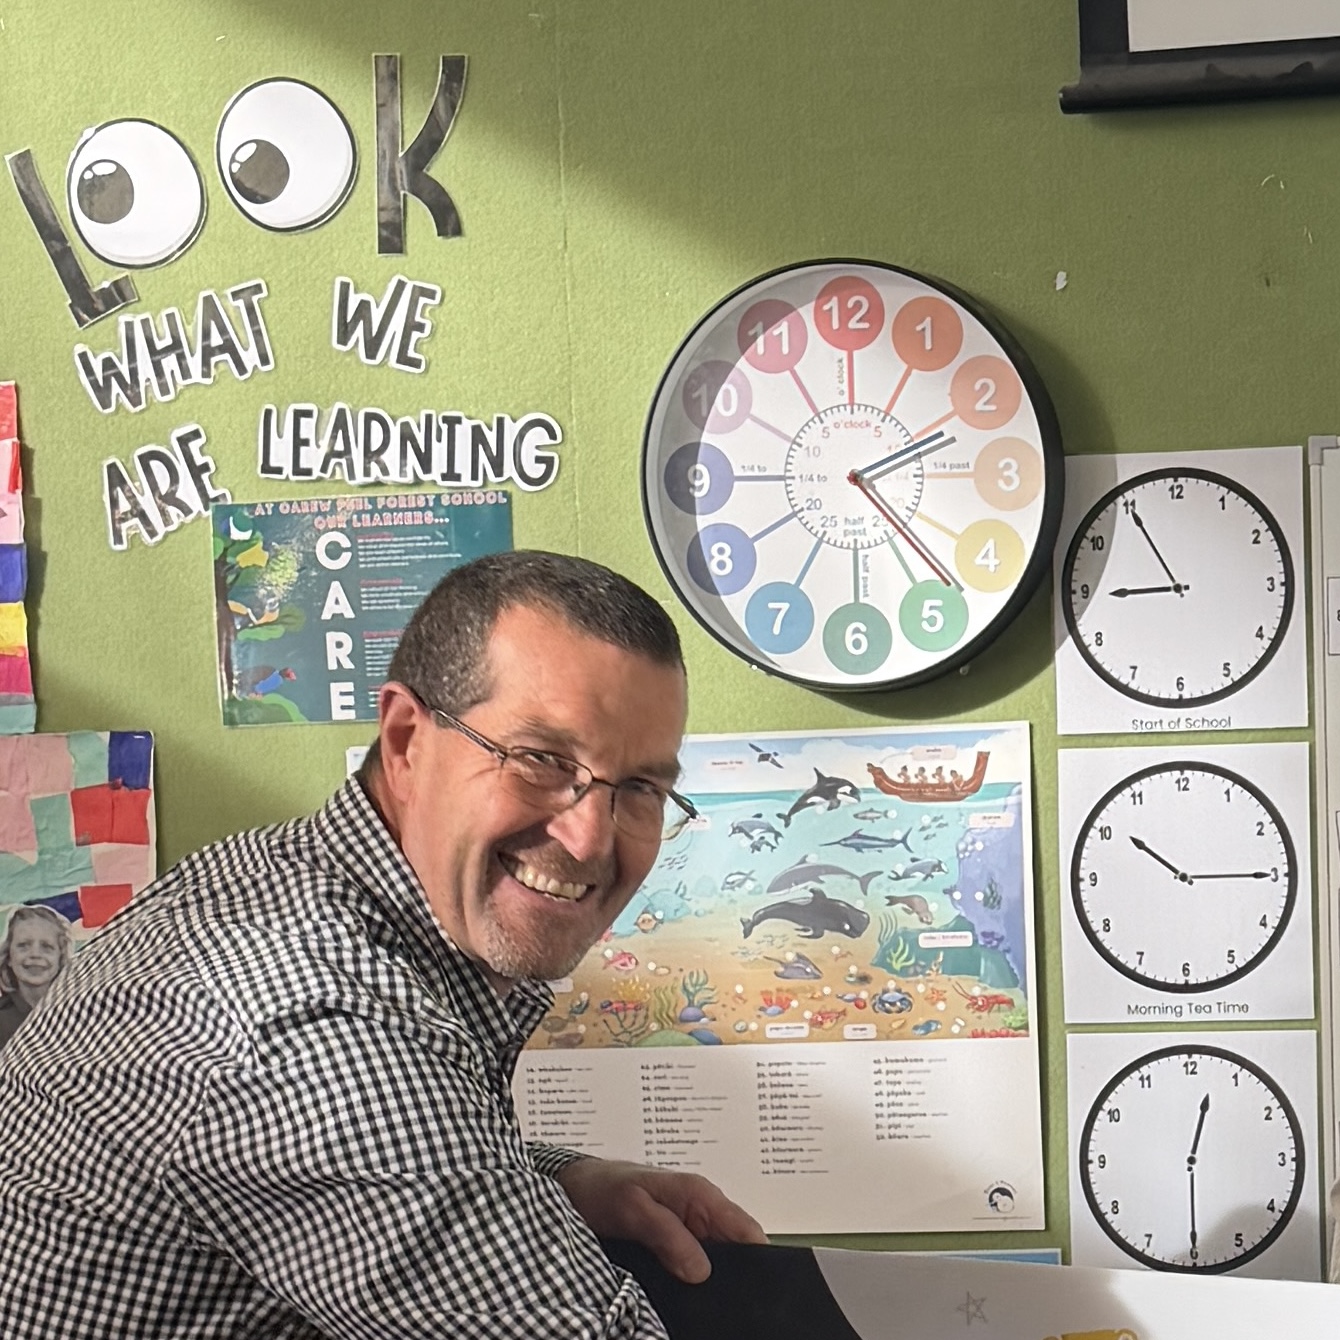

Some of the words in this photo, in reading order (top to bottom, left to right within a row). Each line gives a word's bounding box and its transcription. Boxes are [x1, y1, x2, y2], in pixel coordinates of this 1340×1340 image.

[822, 295, 871, 331] 12
[748, 322, 790, 356] 11
[915, 316, 934, 351] 1
[76, 281, 275, 412] WHAT
[333, 277, 441, 372] WE
[692, 384, 739, 417] 10
[973, 378, 997, 412] 2
[821, 427, 830, 439] 5
[873, 425, 882, 438] 5
[104, 426, 231, 549] ARE
[260, 405, 561, 490] LEARNING
[686, 463, 711, 498] 9
[997, 457, 1021, 492] 3
[1168, 485, 1184, 500] 12
[254, 501, 274, 516] AT
[377, 495, 435, 509] FOREST
[441, 490, 508, 506] SCHOOL
[805, 498, 822, 510] 20
[1123, 499, 1136, 515] 11
[1219, 495, 1226, 510] 1
[820, 515, 838, 528] 25
[844, 516, 864, 526] half
[843, 527, 867, 537] past
[1252, 529, 1261, 545] 2
[1090, 536, 1104, 551] 10
[709, 541, 733, 576] 8
[974, 538, 1001, 573] 4
[1081, 584, 1089, 600] 9
[1267, 577, 1275, 592] 3
[766, 602, 791, 636] 7
[920, 599, 944, 633] 5
[844, 621, 869, 656] 6
[1095, 632, 1103, 647] 8
[1255, 626, 1264, 640] 4
[1130, 666, 1138, 681] 7
[1223, 663, 1231, 678] 5
[1176, 677, 1185, 692] 6
[1132, 718, 1164, 730] Start
[1168, 717, 1181, 729] of
[1185, 716, 1232, 729] School
[1175, 777, 1190, 792] 12
[1130, 791, 1143, 805] 11
[1224, 789, 1231, 802] 1
[1099, 826, 1112, 840] 10
[1256, 822, 1265, 836] 2
[1089, 872, 1098, 887] 9
[1271, 867, 1279, 882] 3
[1102, 918, 1111, 932] 8
[1259, 914, 1267, 928] 4
[1137, 952, 1145, 966] 7
[1227, 949, 1235, 964] 5
[1182, 962, 1190, 977] 6
[1127, 1003, 1183, 1017] Morning
[1188, 1002, 1212, 1014] Tea
[1216, 1000, 1249, 1014] Time
[1183, 1061, 1198, 1076] 12
[1138, 1074, 1152, 1088] 11
[1232, 1073, 1239, 1087] 1
[1107, 1108, 1120, 1123] 10
[1264, 1107, 1272, 1121] 2
[1098, 1154, 1107, 1169] 9
[1278, 1152, 1287, 1167] 3
[1111, 1200, 1120, 1214] 8
[1267, 1199, 1275, 1213] 4
[1145, 1234, 1153, 1248] 7
[1235, 1233, 1243, 1247] 5
